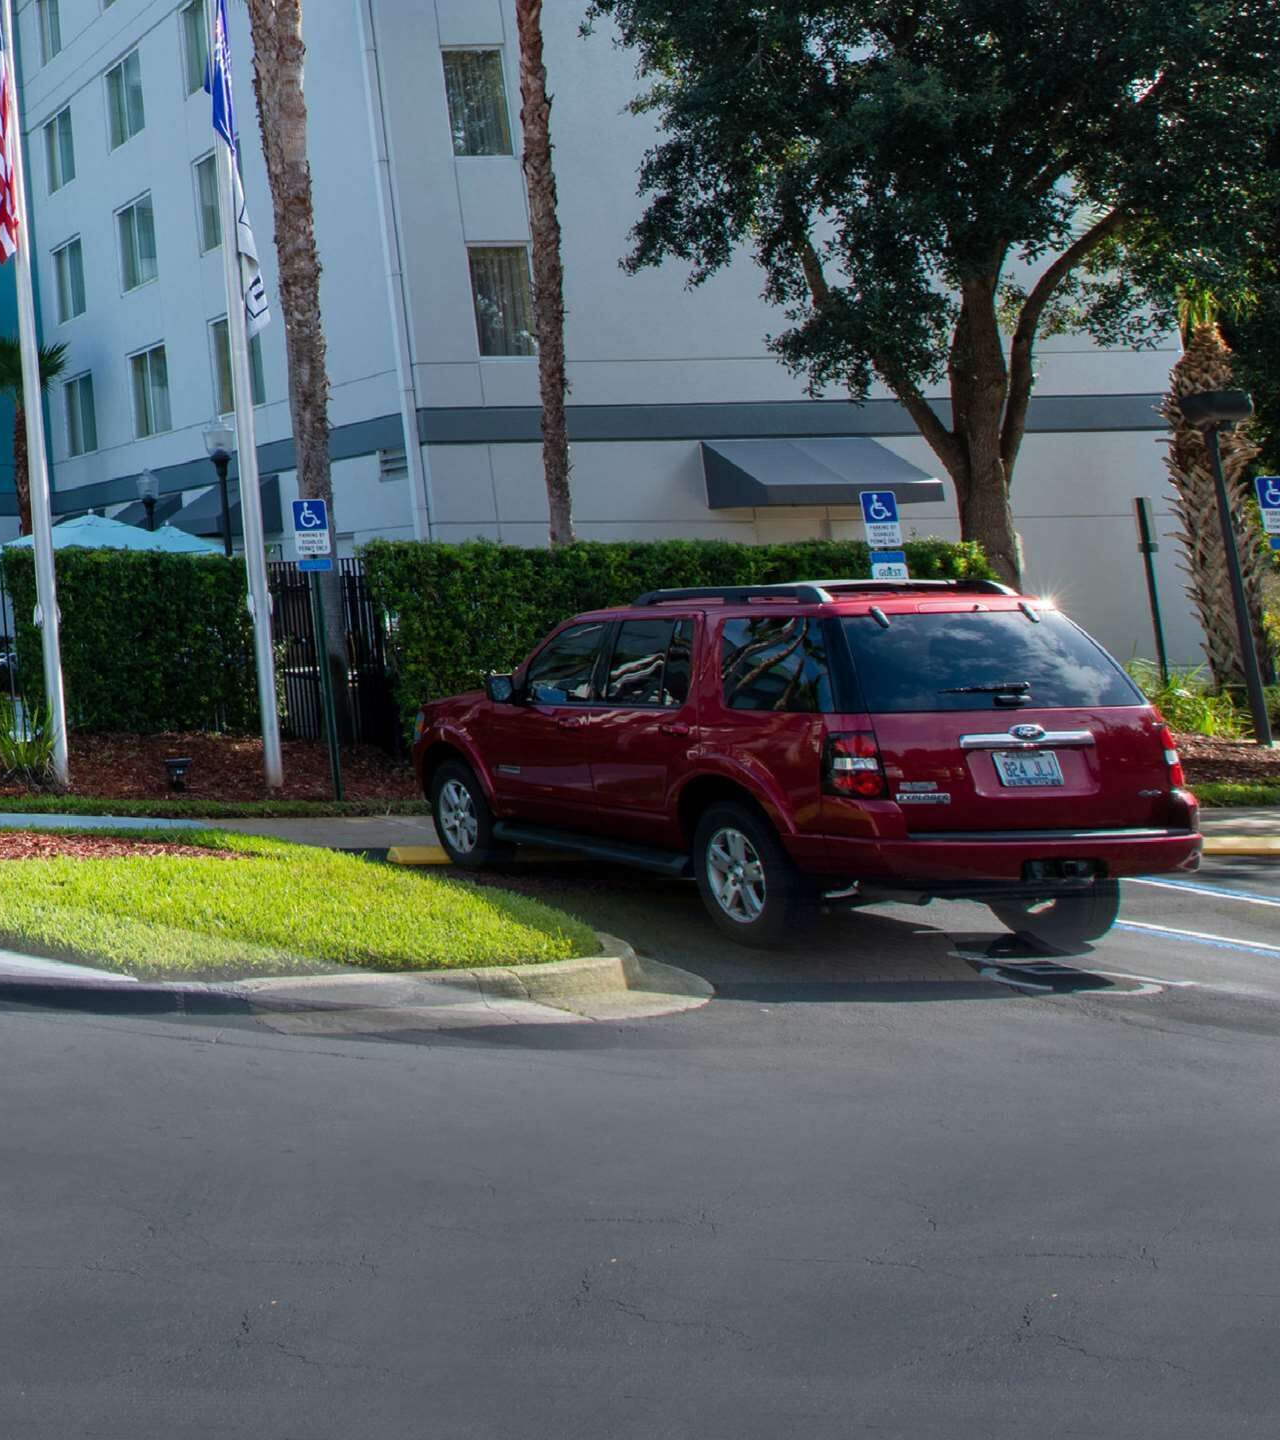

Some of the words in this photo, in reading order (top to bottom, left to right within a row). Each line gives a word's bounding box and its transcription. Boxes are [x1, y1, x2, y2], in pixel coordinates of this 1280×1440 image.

[878, 568, 901, 577] GUEST
[1003, 761, 1028, 778] 824
[898, 793, 950, 802] EXPLORER
